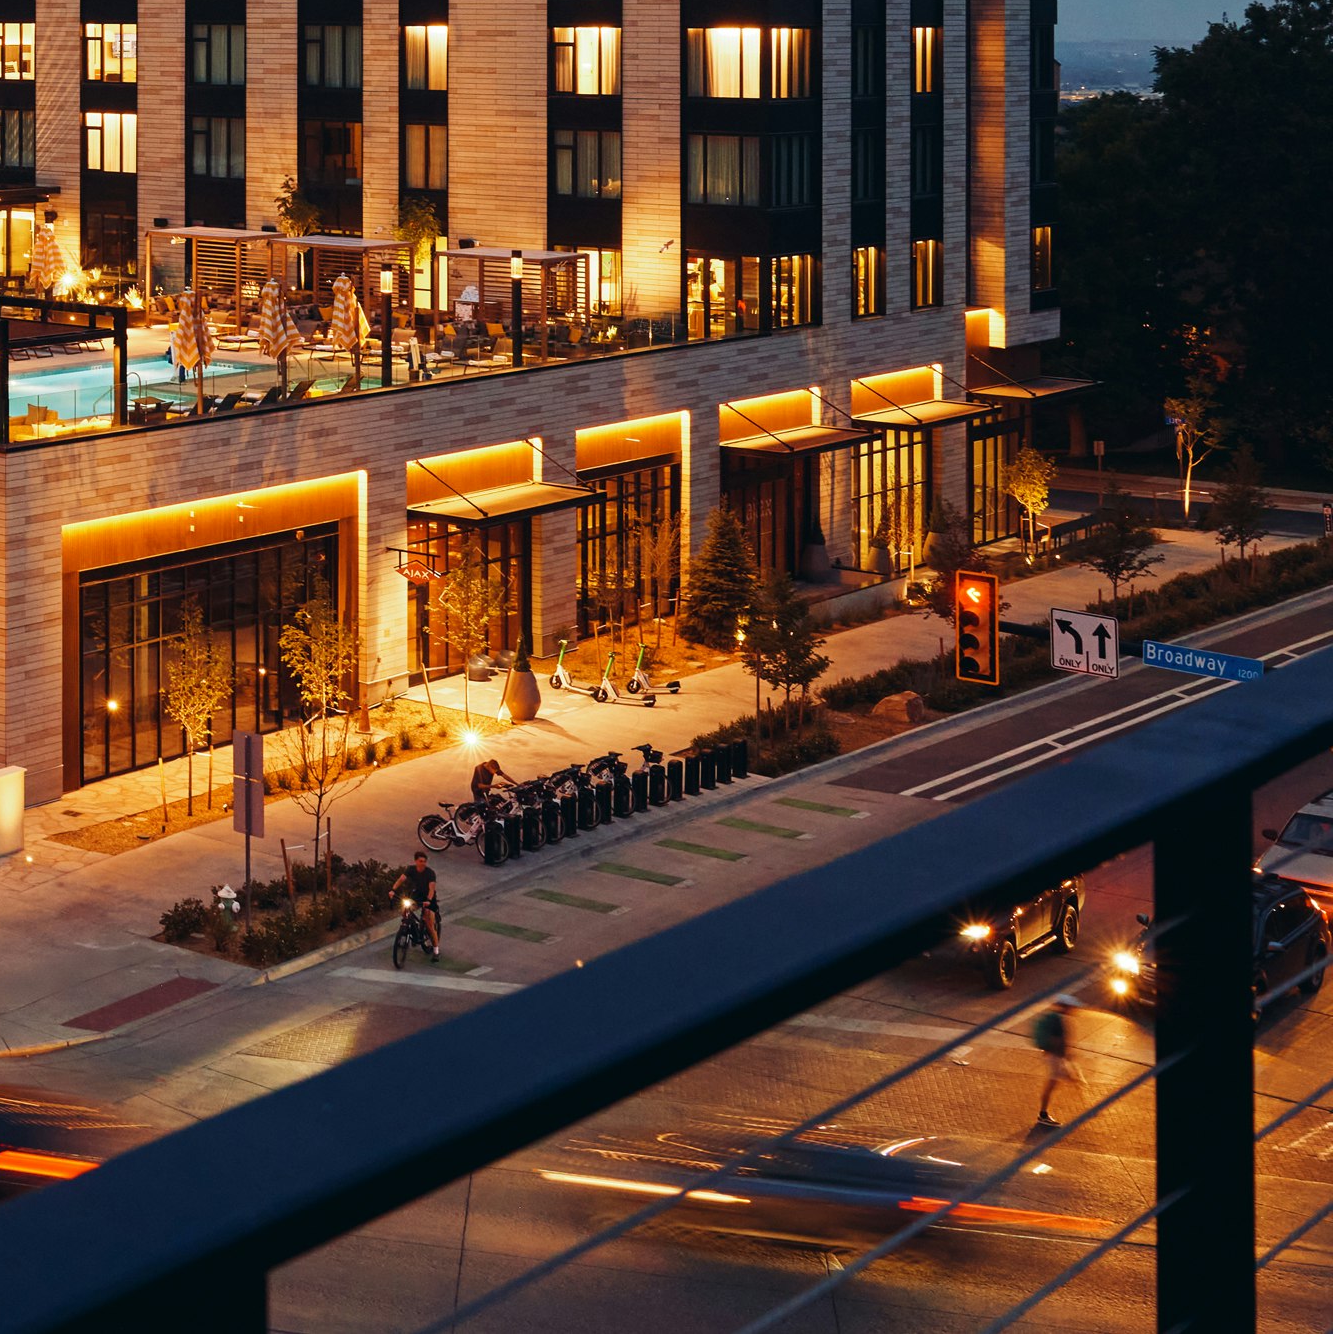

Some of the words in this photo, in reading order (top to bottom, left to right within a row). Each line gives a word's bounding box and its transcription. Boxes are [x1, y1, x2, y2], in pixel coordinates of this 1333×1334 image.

[403, 569, 430, 580] AJAX
[1059, 657, 1081, 668] ONLY
[1146, 644, 1227, 676] Broadway
[1091, 663, 1115, 674] ONLY
